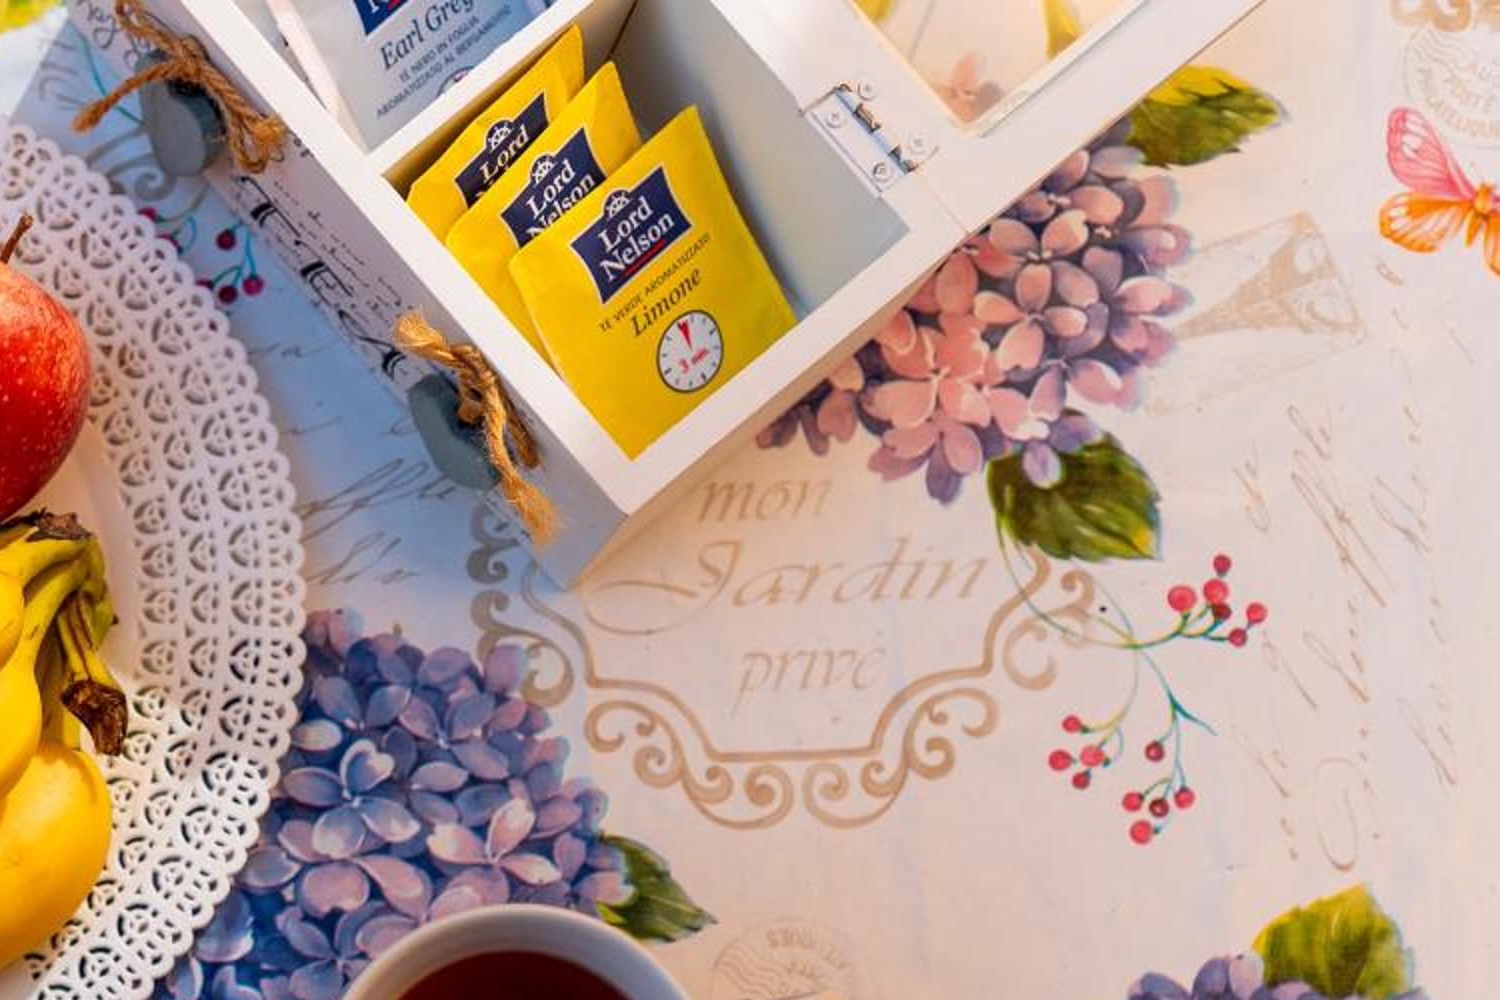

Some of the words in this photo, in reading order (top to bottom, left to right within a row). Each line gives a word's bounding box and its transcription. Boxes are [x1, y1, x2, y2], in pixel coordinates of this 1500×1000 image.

[380, 19, 424, 70] Earl
[480, 123, 530, 184] Lord
[526, 157, 576, 219] Lord
[598, 195, 653, 253] Lord
[600, 213, 675, 281] Nelson
[630, 267, 701, 337] Limone
[699, 478, 834, 522] mon
[584, 536, 991, 636] Jardin
